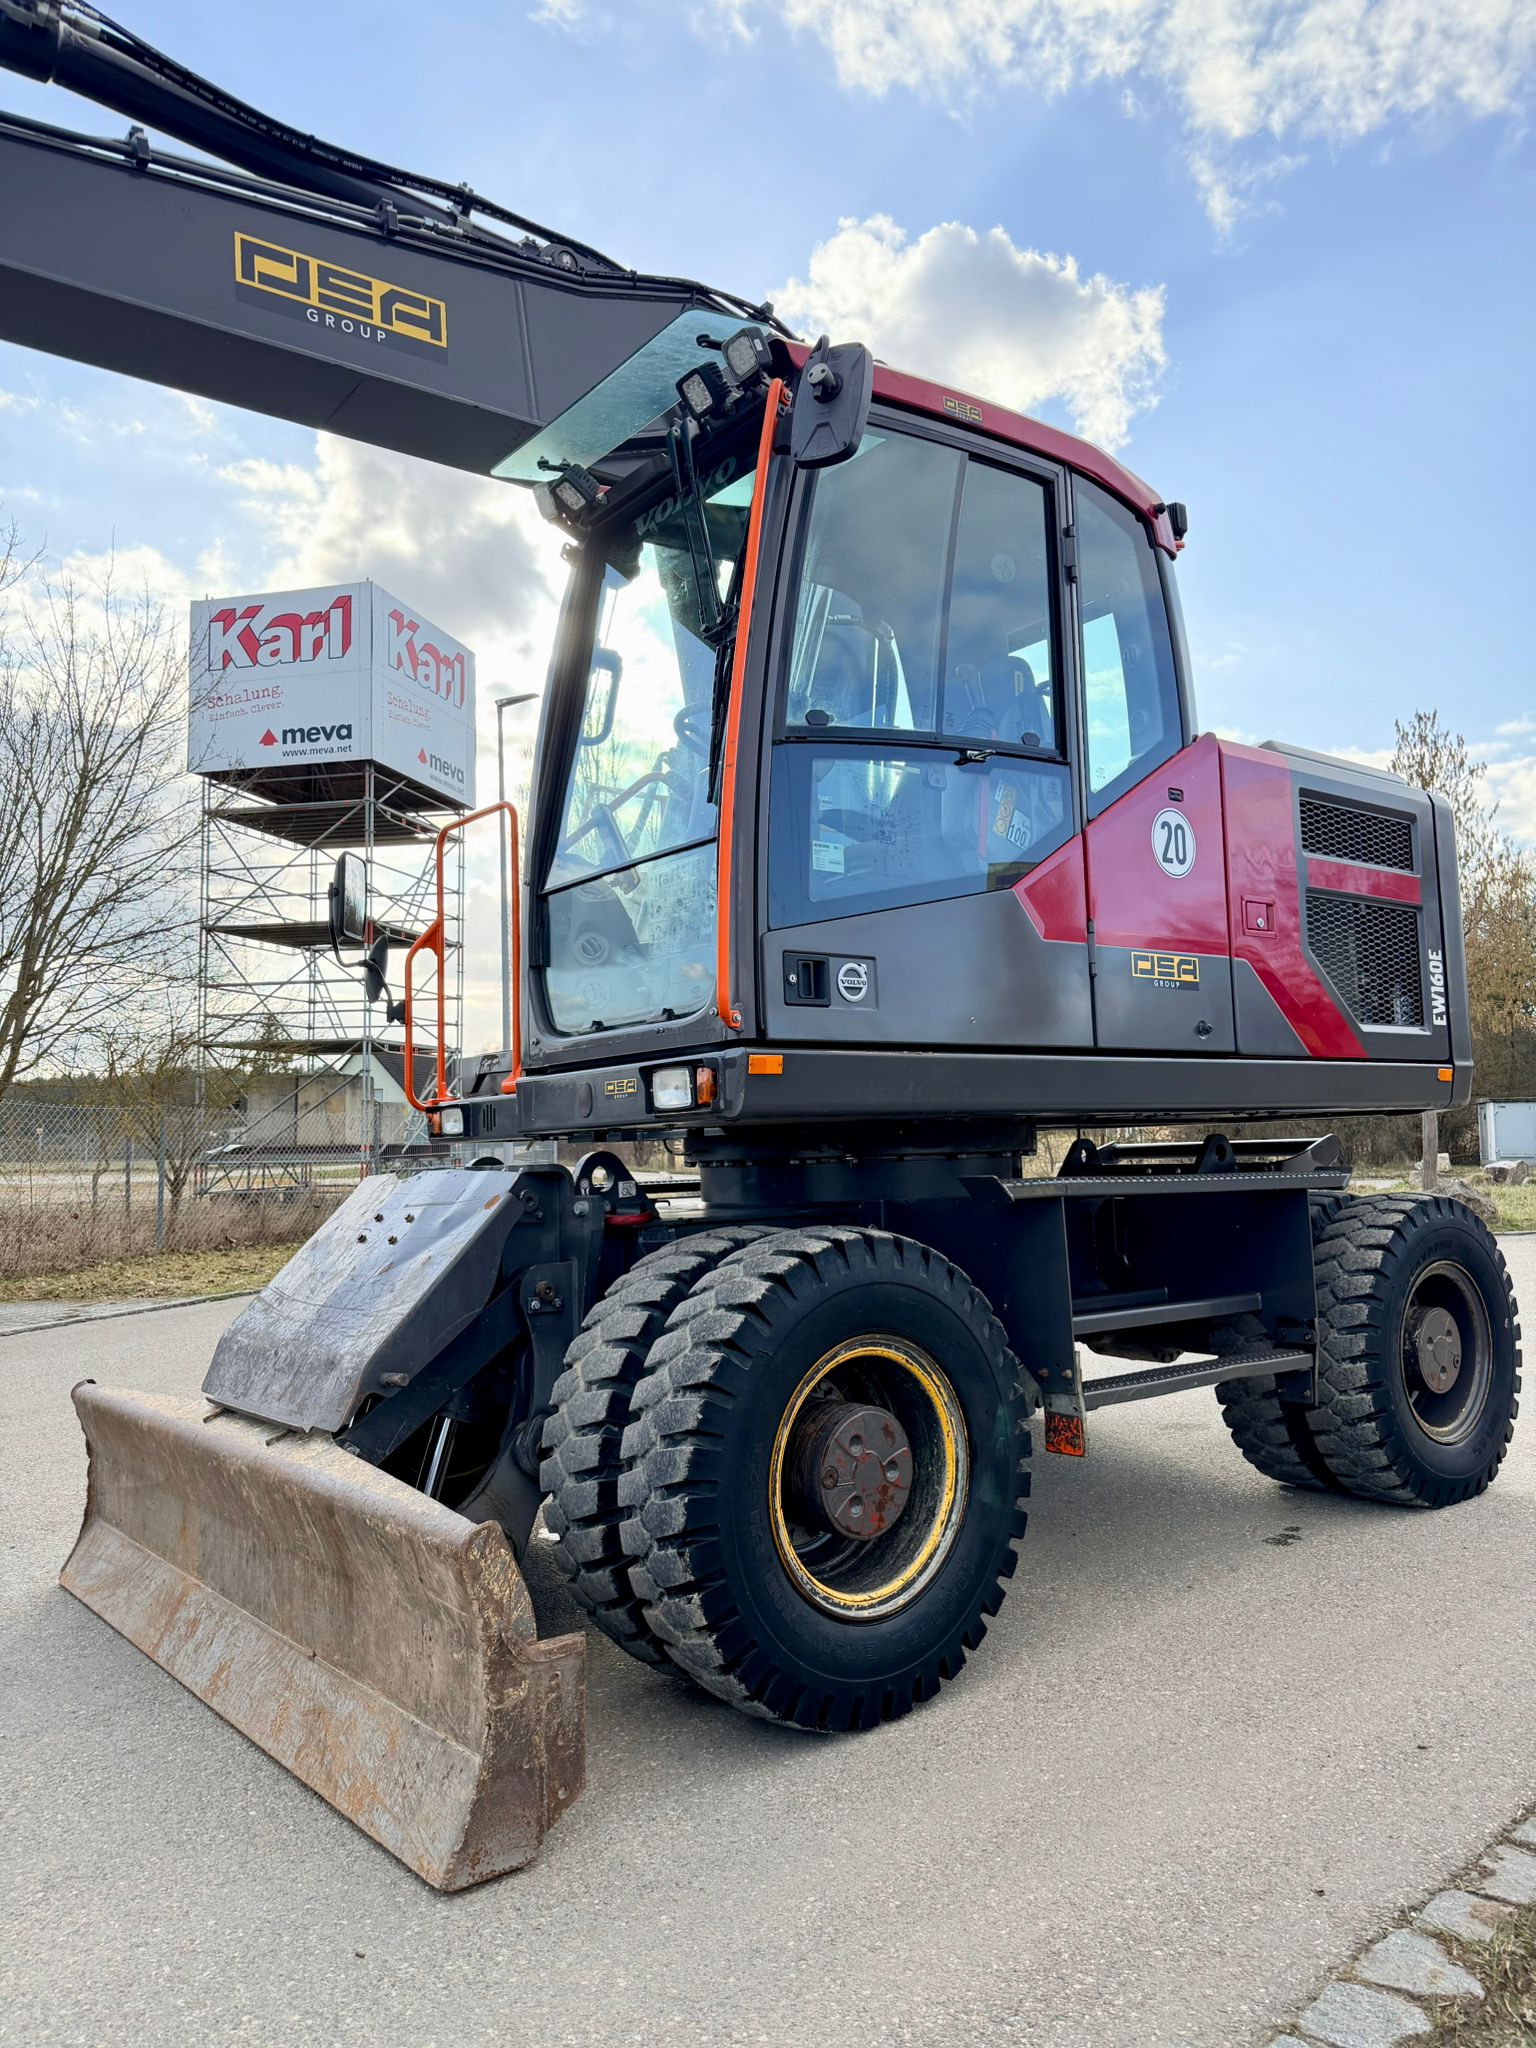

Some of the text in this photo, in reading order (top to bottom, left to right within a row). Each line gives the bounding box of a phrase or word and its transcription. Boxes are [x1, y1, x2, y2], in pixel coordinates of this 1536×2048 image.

[306, 308, 386, 342] GROUP
[208, 595, 352, 671] Karl
[388, 608, 465, 710] Karl
[207, 685, 284, 710] Schalung.
[250, 700, 285, 714] Clever.
[281, 723, 352, 745] meva
[282, 744, 352, 757] www.meva.net
[429, 752, 465, 785] meva
[1009, 823, 1027, 847] 100
[1160, 820, 1186, 866] 20
[840, 978, 867, 986] VOLVO
[1153, 979, 1180, 988] GROUP
[1428, 948, 1447, 1026] EW160E
